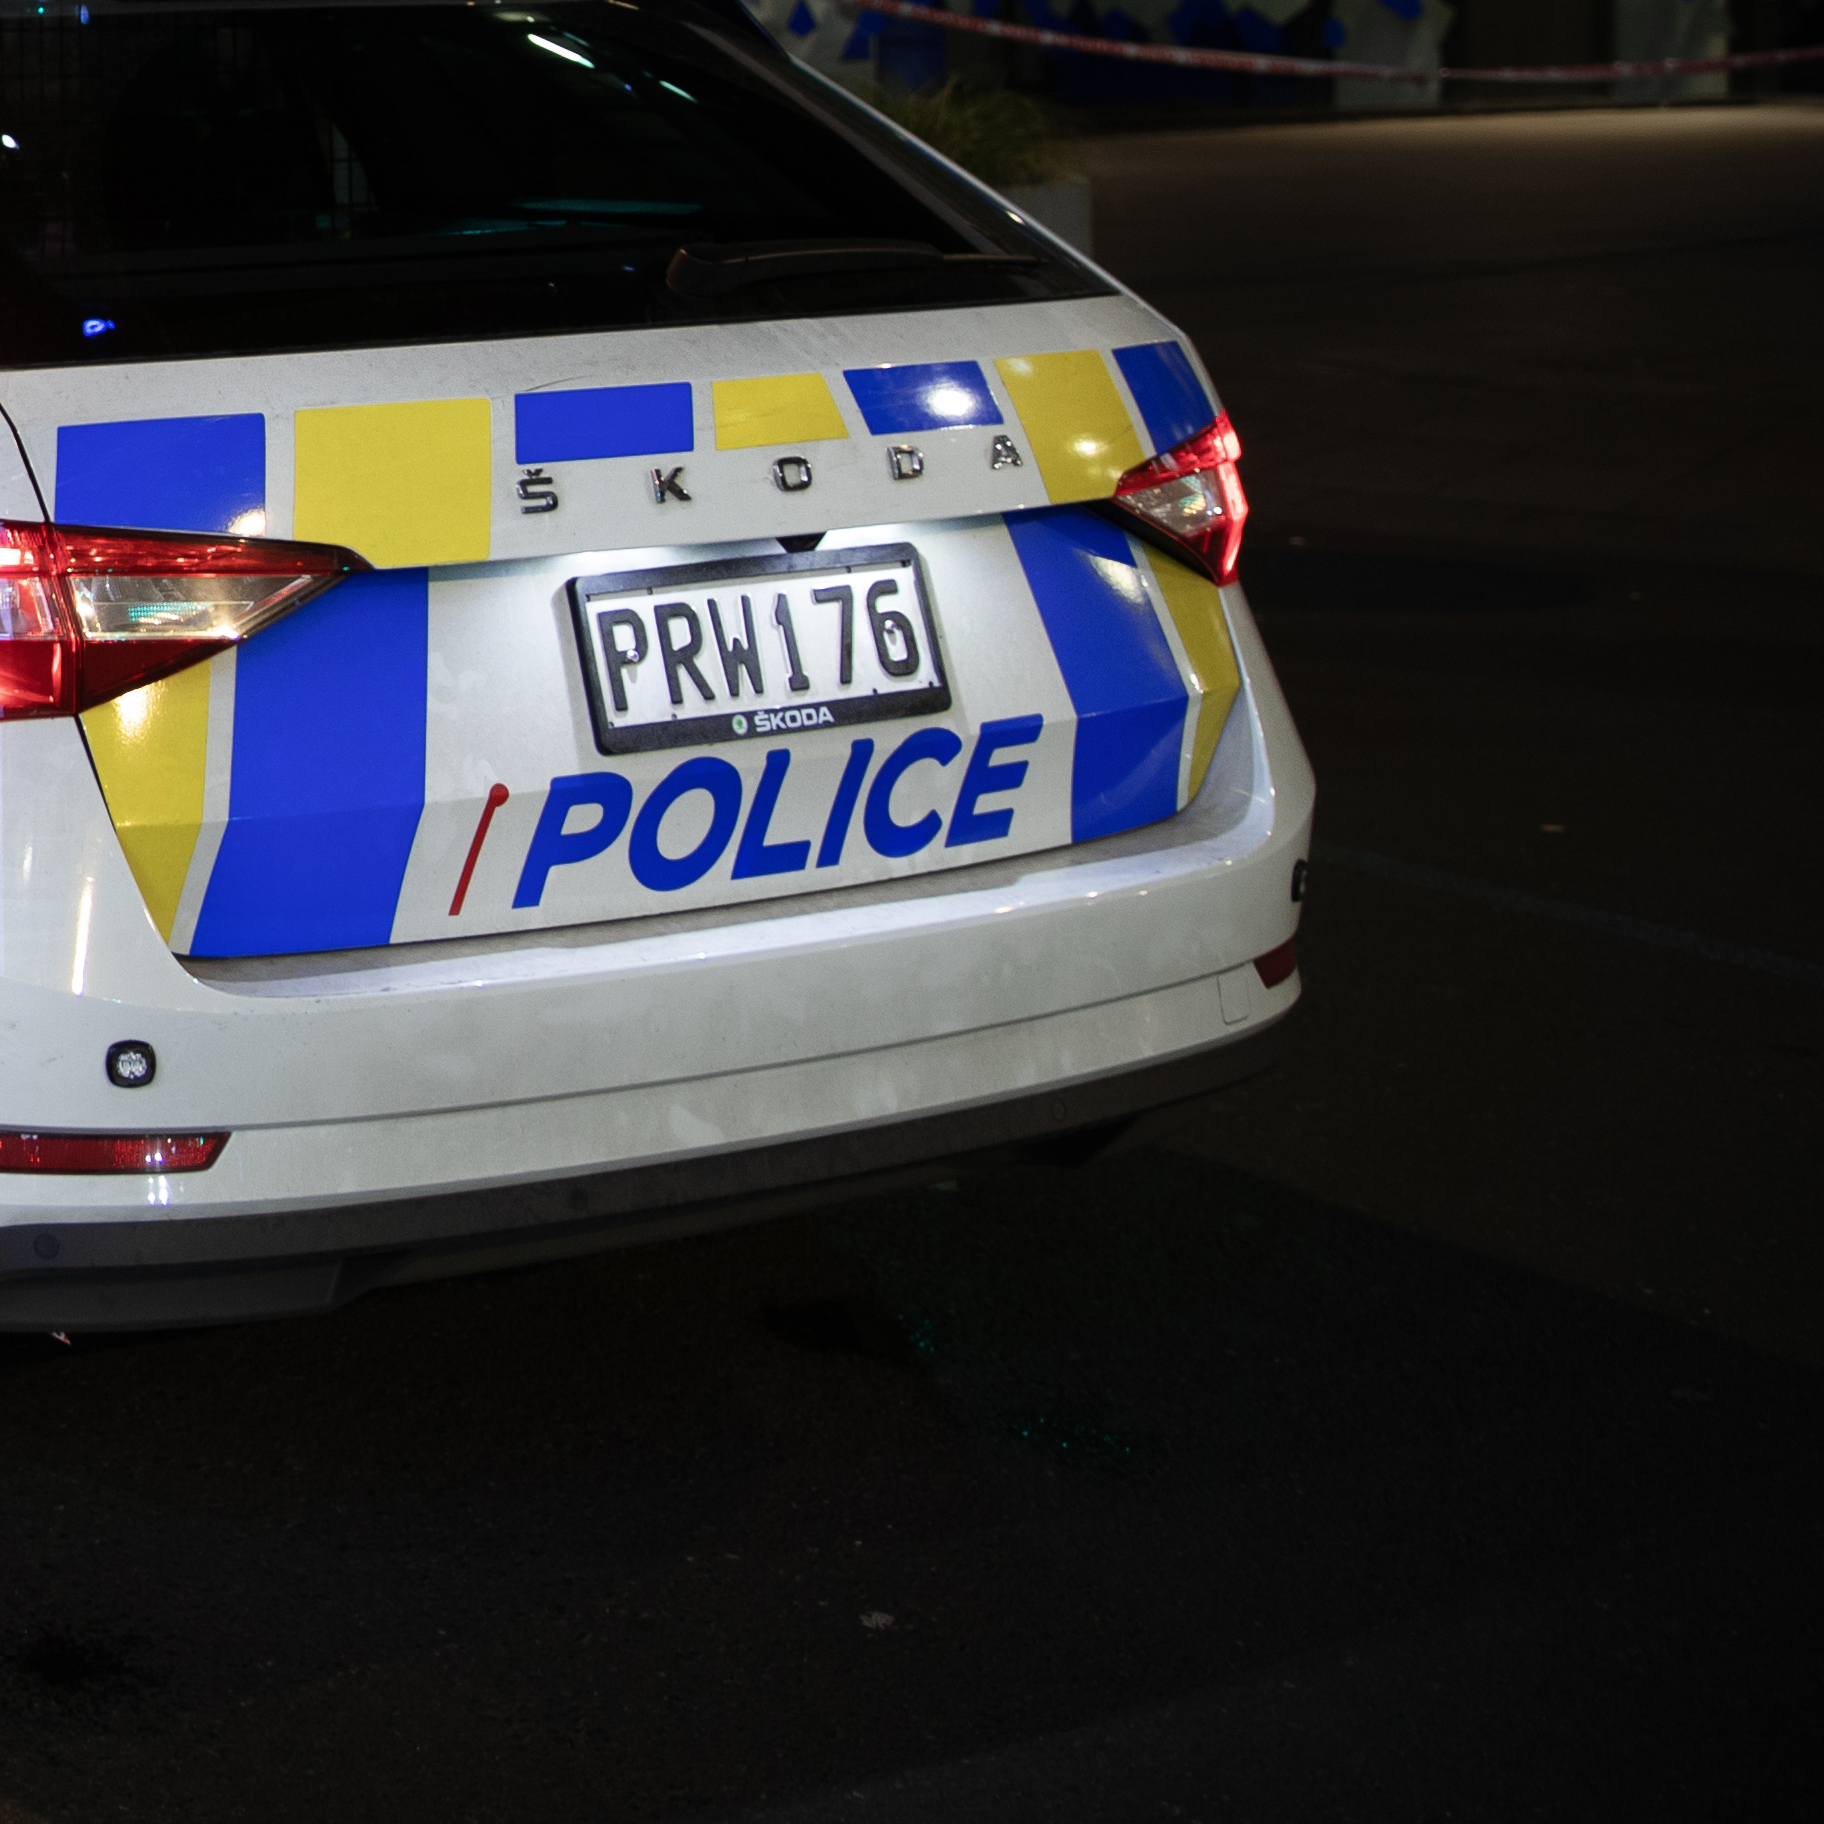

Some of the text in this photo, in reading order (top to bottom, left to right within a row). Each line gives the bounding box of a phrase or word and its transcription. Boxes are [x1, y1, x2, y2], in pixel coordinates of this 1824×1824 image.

[597, 578, 922, 713] PRW176
[753, 705, 835, 734] ŠKODA
[510, 713, 1045, 910] POLICE
